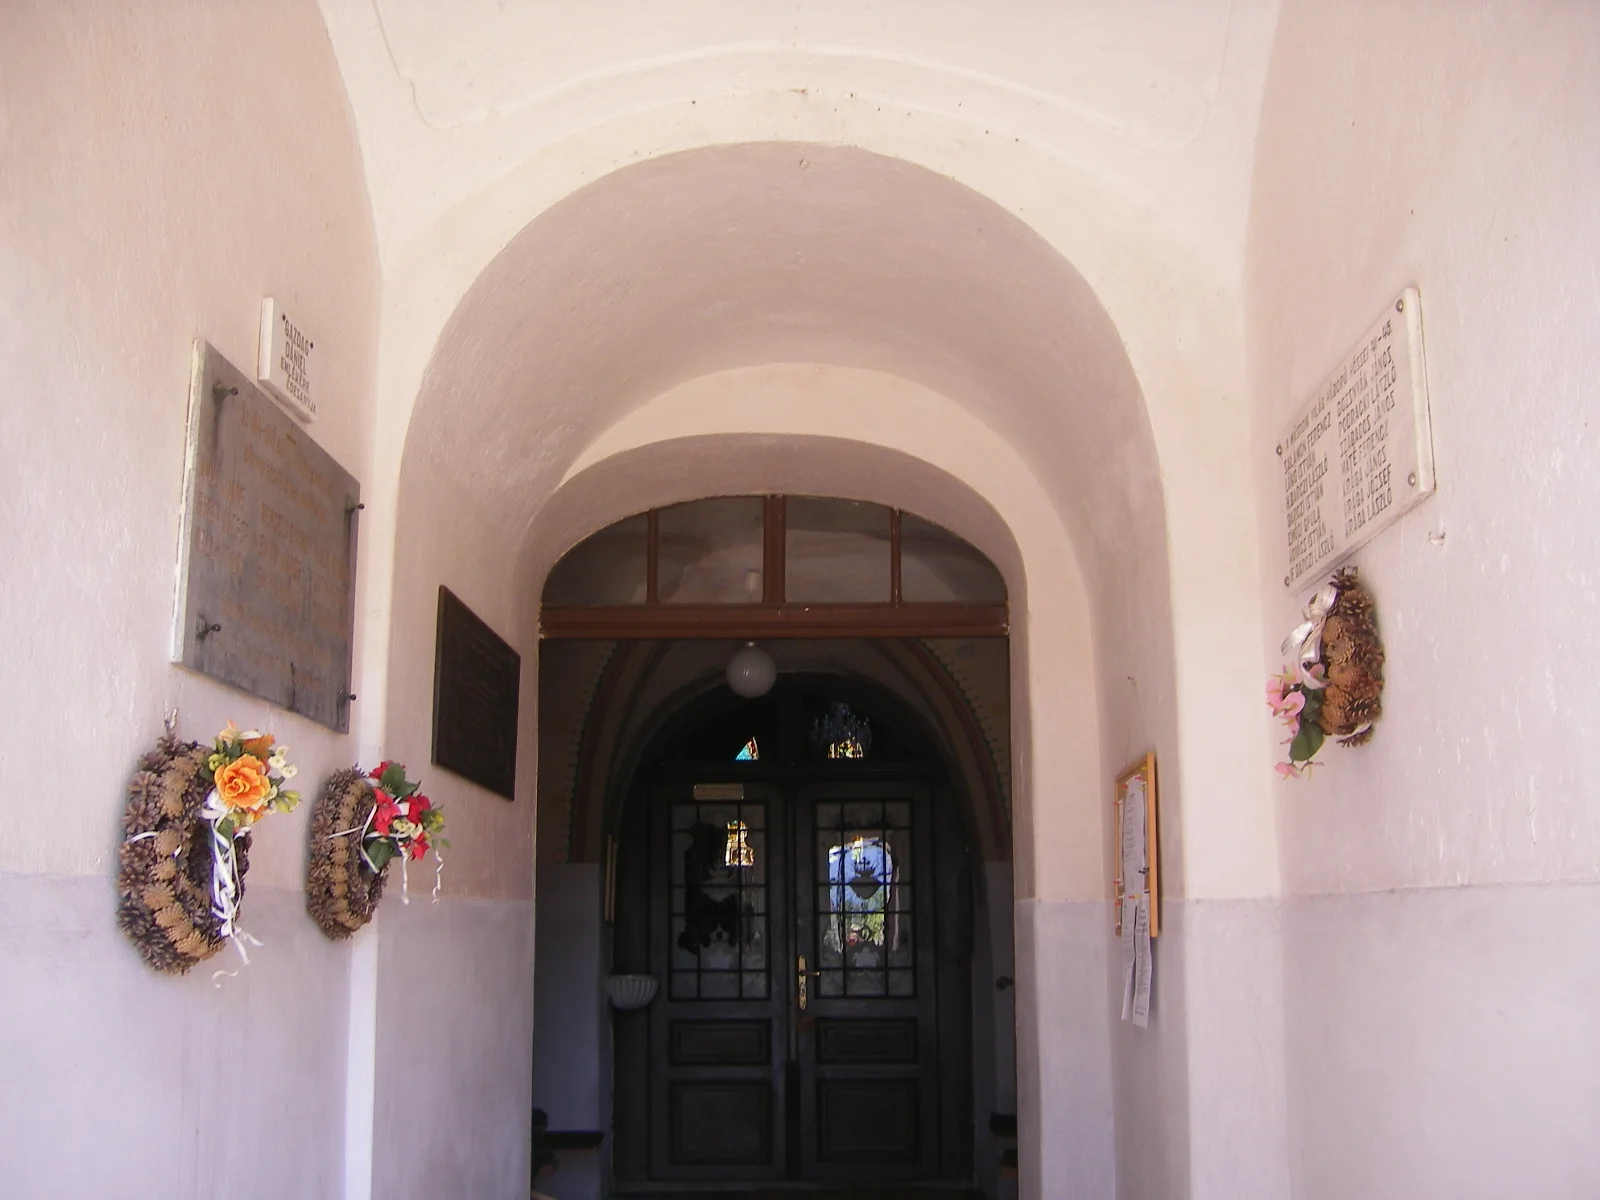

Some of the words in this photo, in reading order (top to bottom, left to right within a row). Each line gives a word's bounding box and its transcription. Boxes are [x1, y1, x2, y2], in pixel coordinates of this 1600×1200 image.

[285, 319, 309, 357] GAZDAG
[286, 339, 306, 376] DÁNIEL
[1369, 342, 1392, 383] JÁNOS
[1370, 362, 1396, 404] LÁSZLÓ
[1307, 410, 1331, 449] FERENCZ
[1339, 412, 1371, 458] SZABADOS
[1366, 462, 1392, 499] JÓZSEF
[1366, 485, 1392, 521] LÁSZLÓ
